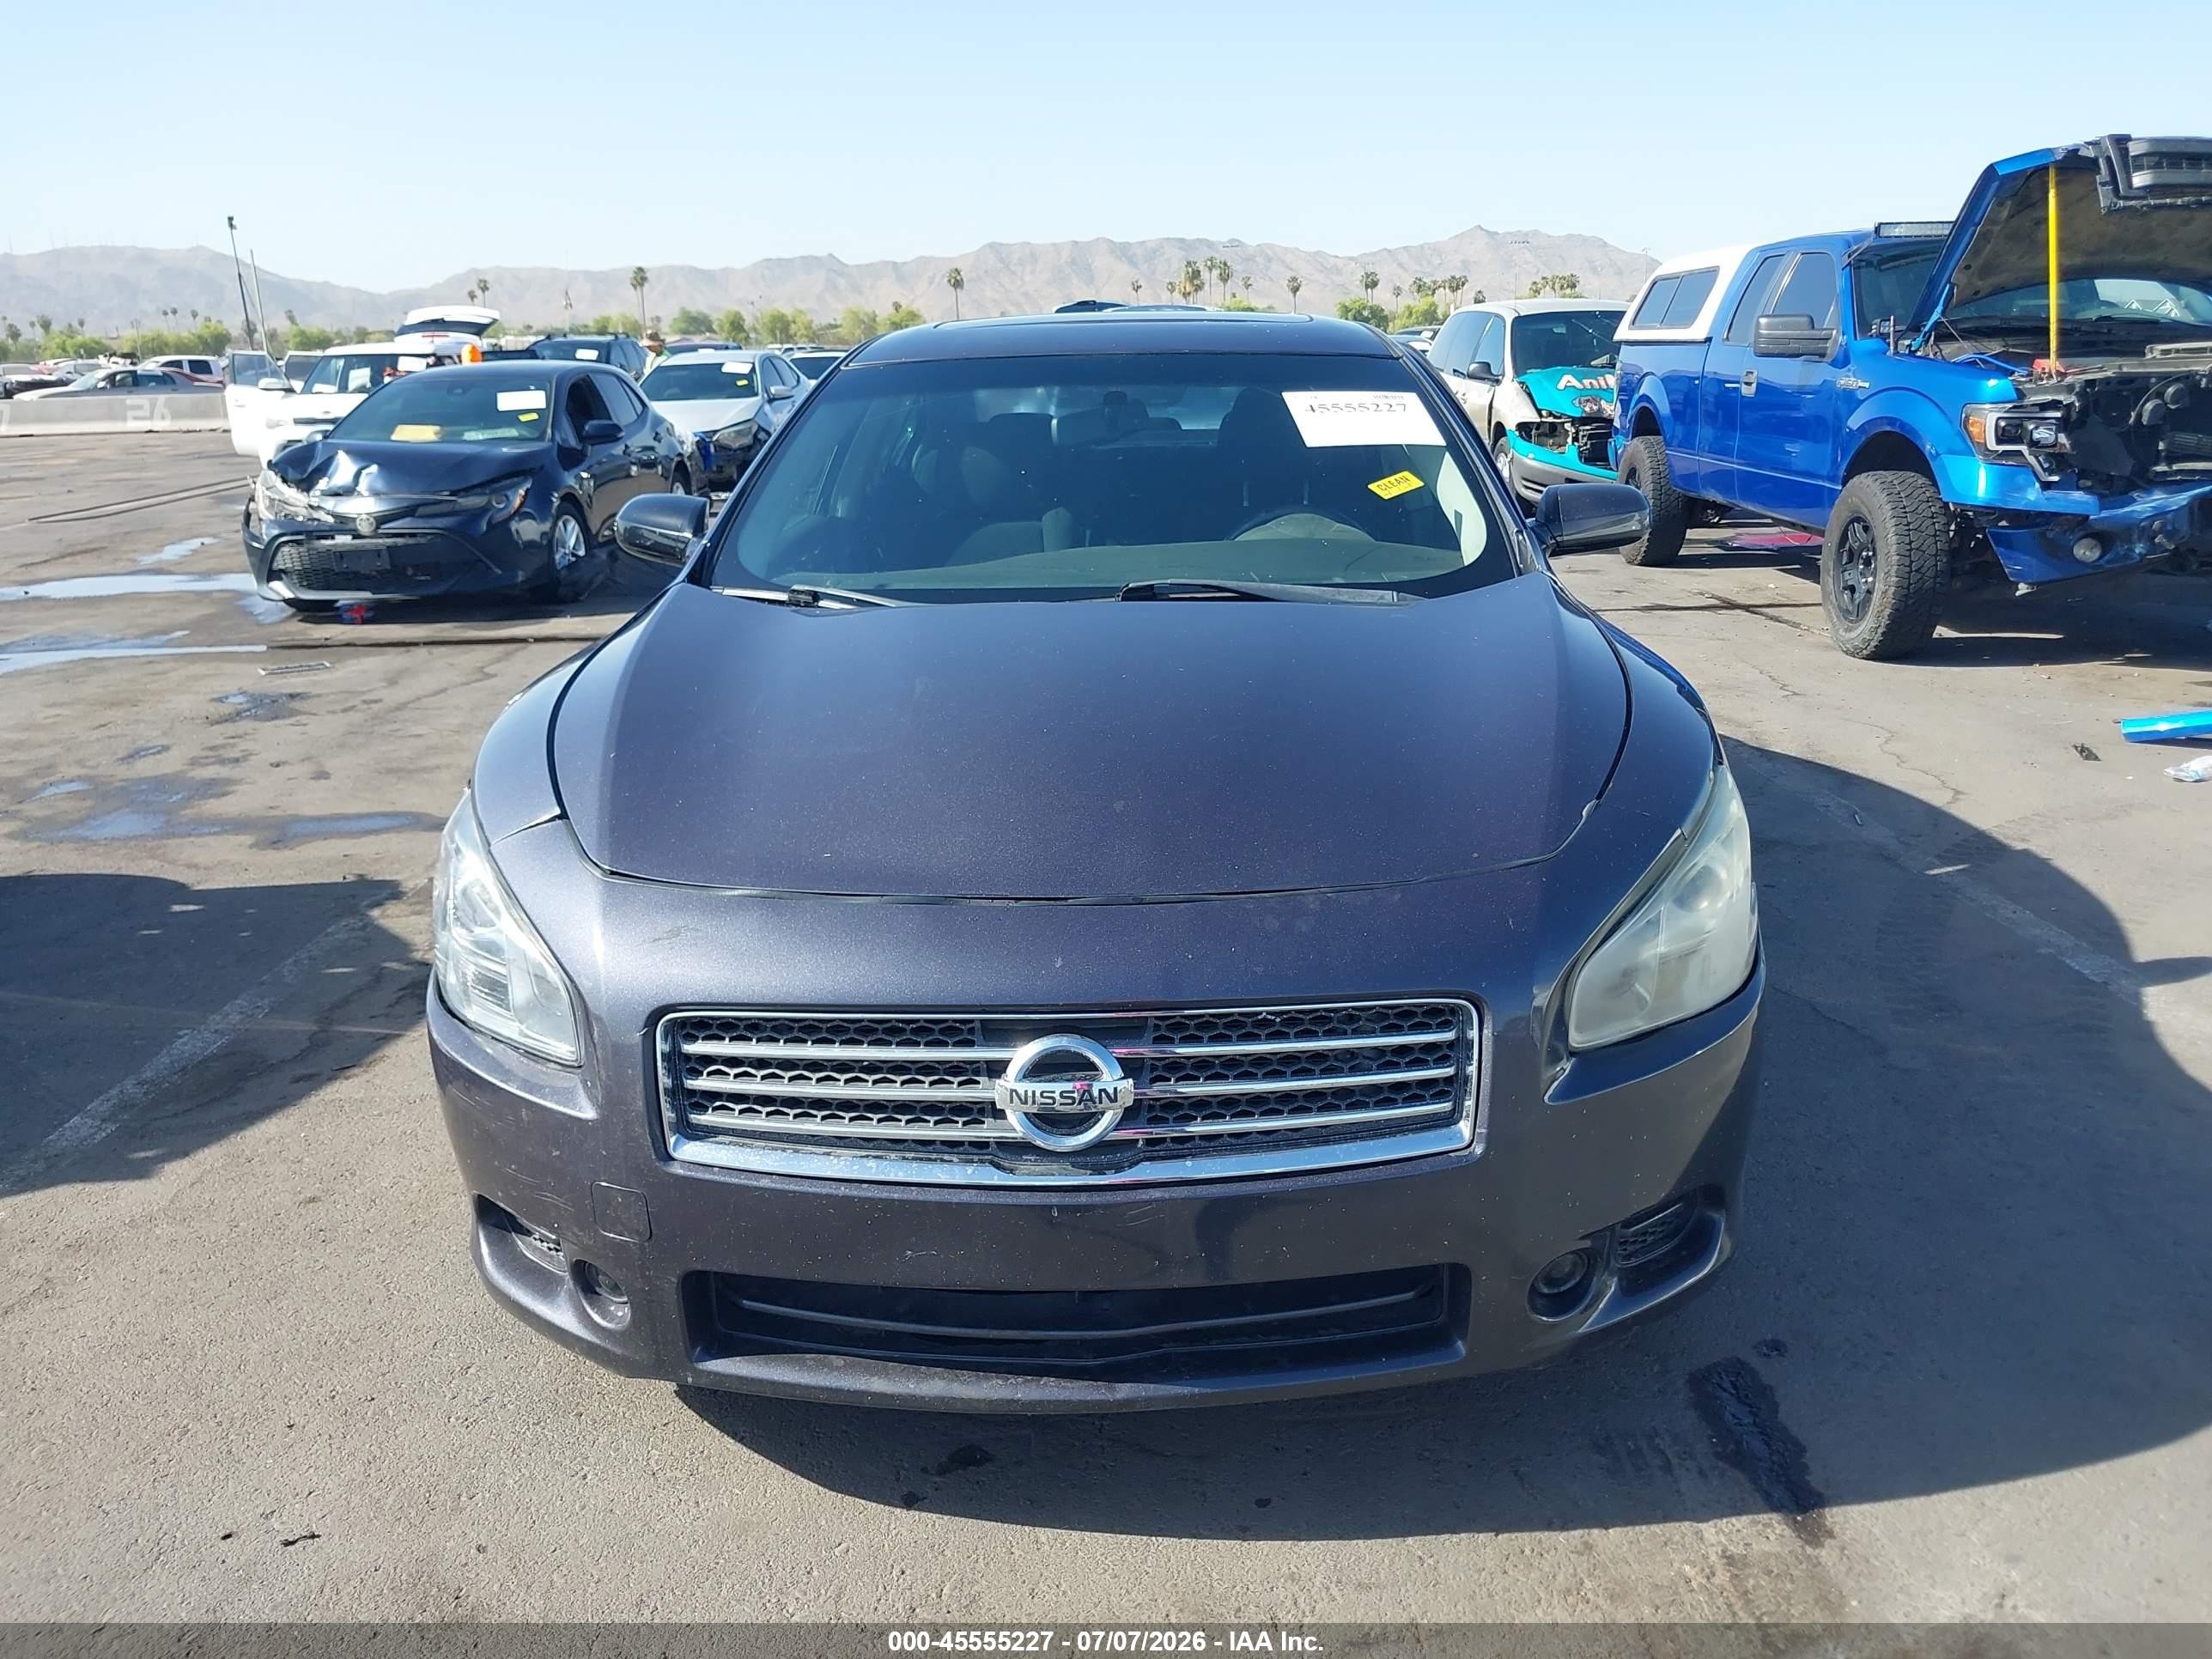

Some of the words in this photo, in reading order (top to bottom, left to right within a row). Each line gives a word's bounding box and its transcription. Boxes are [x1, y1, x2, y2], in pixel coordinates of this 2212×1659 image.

[125, 396, 172, 427] 26
[1376, 475, 1411, 492] CLEAN
[1009, 1086, 1118, 1107] NISSAN
